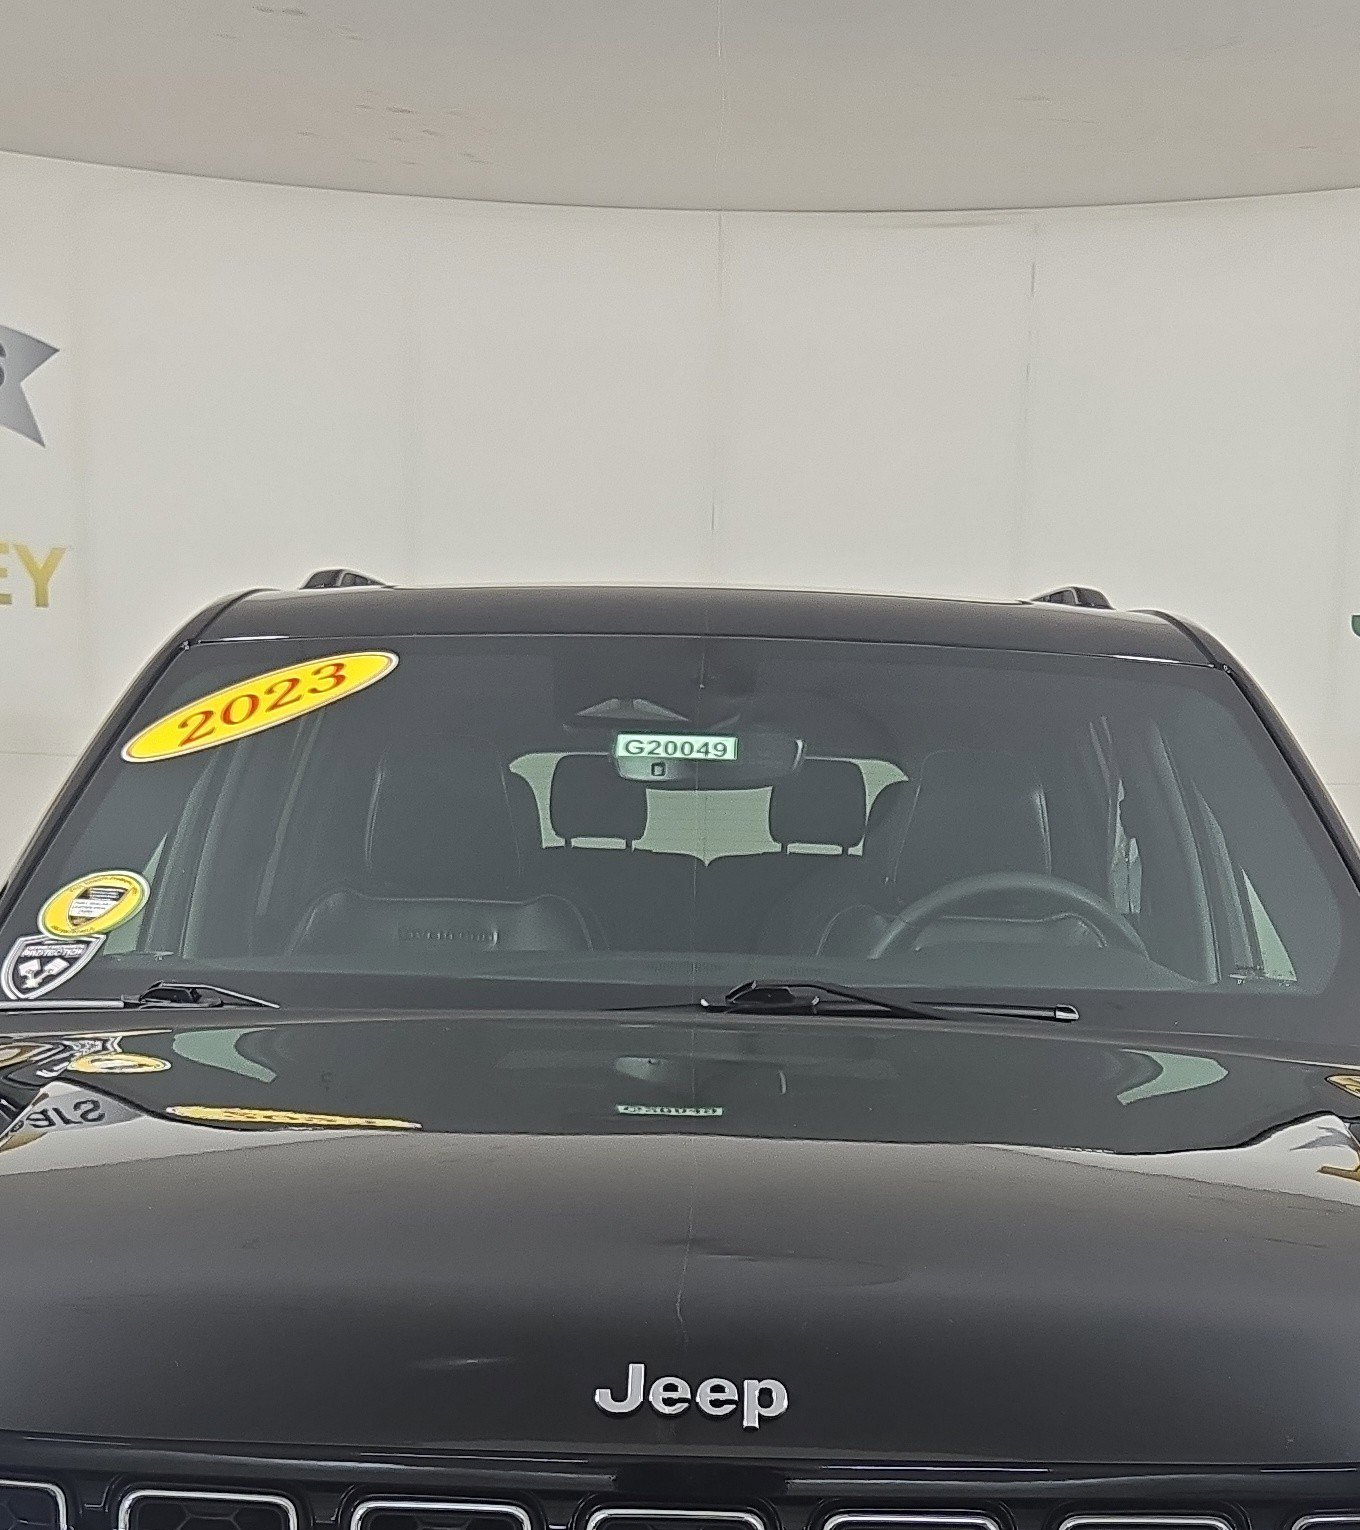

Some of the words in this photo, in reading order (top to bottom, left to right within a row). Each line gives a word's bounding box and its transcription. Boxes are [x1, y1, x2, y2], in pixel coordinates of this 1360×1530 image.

[177, 661, 348, 747] 2023
[625, 738, 728, 758] G20049
[594, 1363, 789, 1429] Jeep
